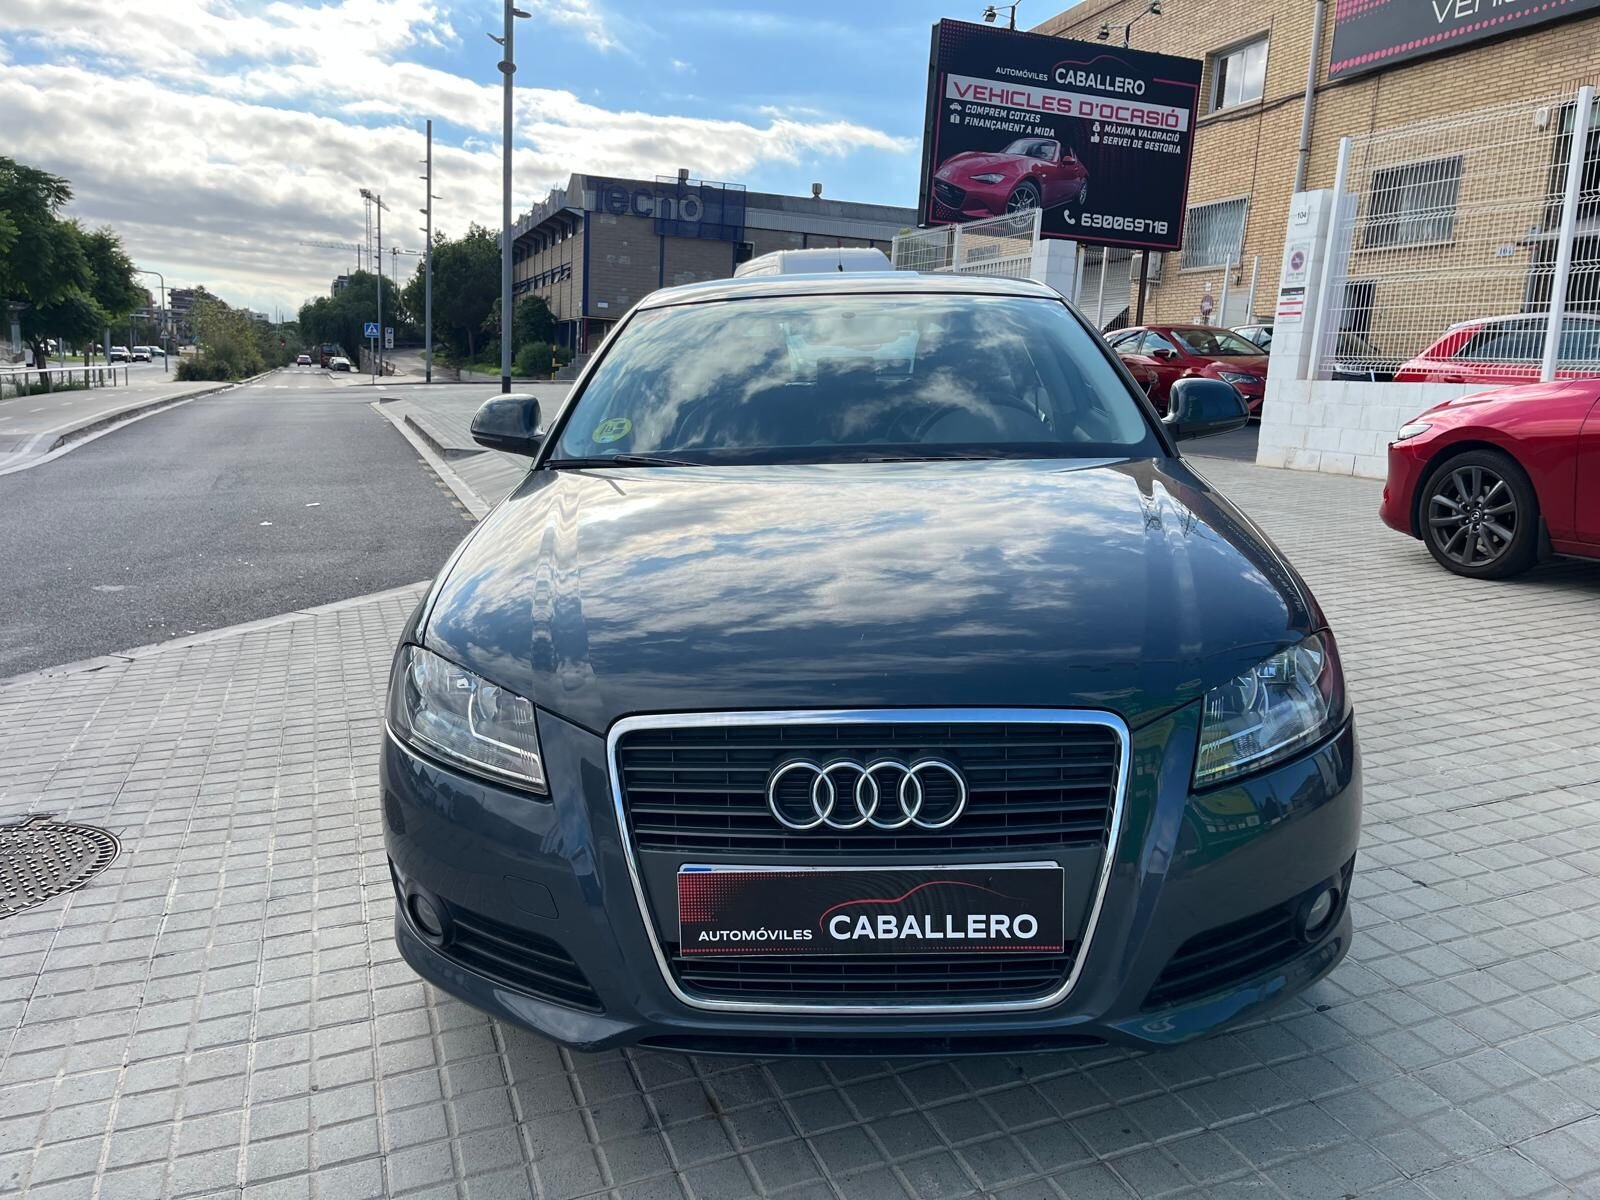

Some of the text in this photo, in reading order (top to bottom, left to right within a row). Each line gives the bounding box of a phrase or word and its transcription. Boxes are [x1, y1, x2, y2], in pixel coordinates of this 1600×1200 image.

[995, 66, 1146, 96] AUTOMÓVILES CABALLERO
[953, 81, 1179, 129] VEHICLES D'OCASIÓ
[965, 104, 1041, 124] COMPREM COTXES
[964, 116, 1056, 138] FINANÇAMENT A MIDA
[1104, 123, 1180, 144] MÀXIMA VALORACIÓ
[1102, 135, 1181, 155] SERVEI DE GESTORIA
[1081, 213, 1168, 235] 630069718
[698, 914, 1039, 942] AUTOMÓVILES CABALLERO
